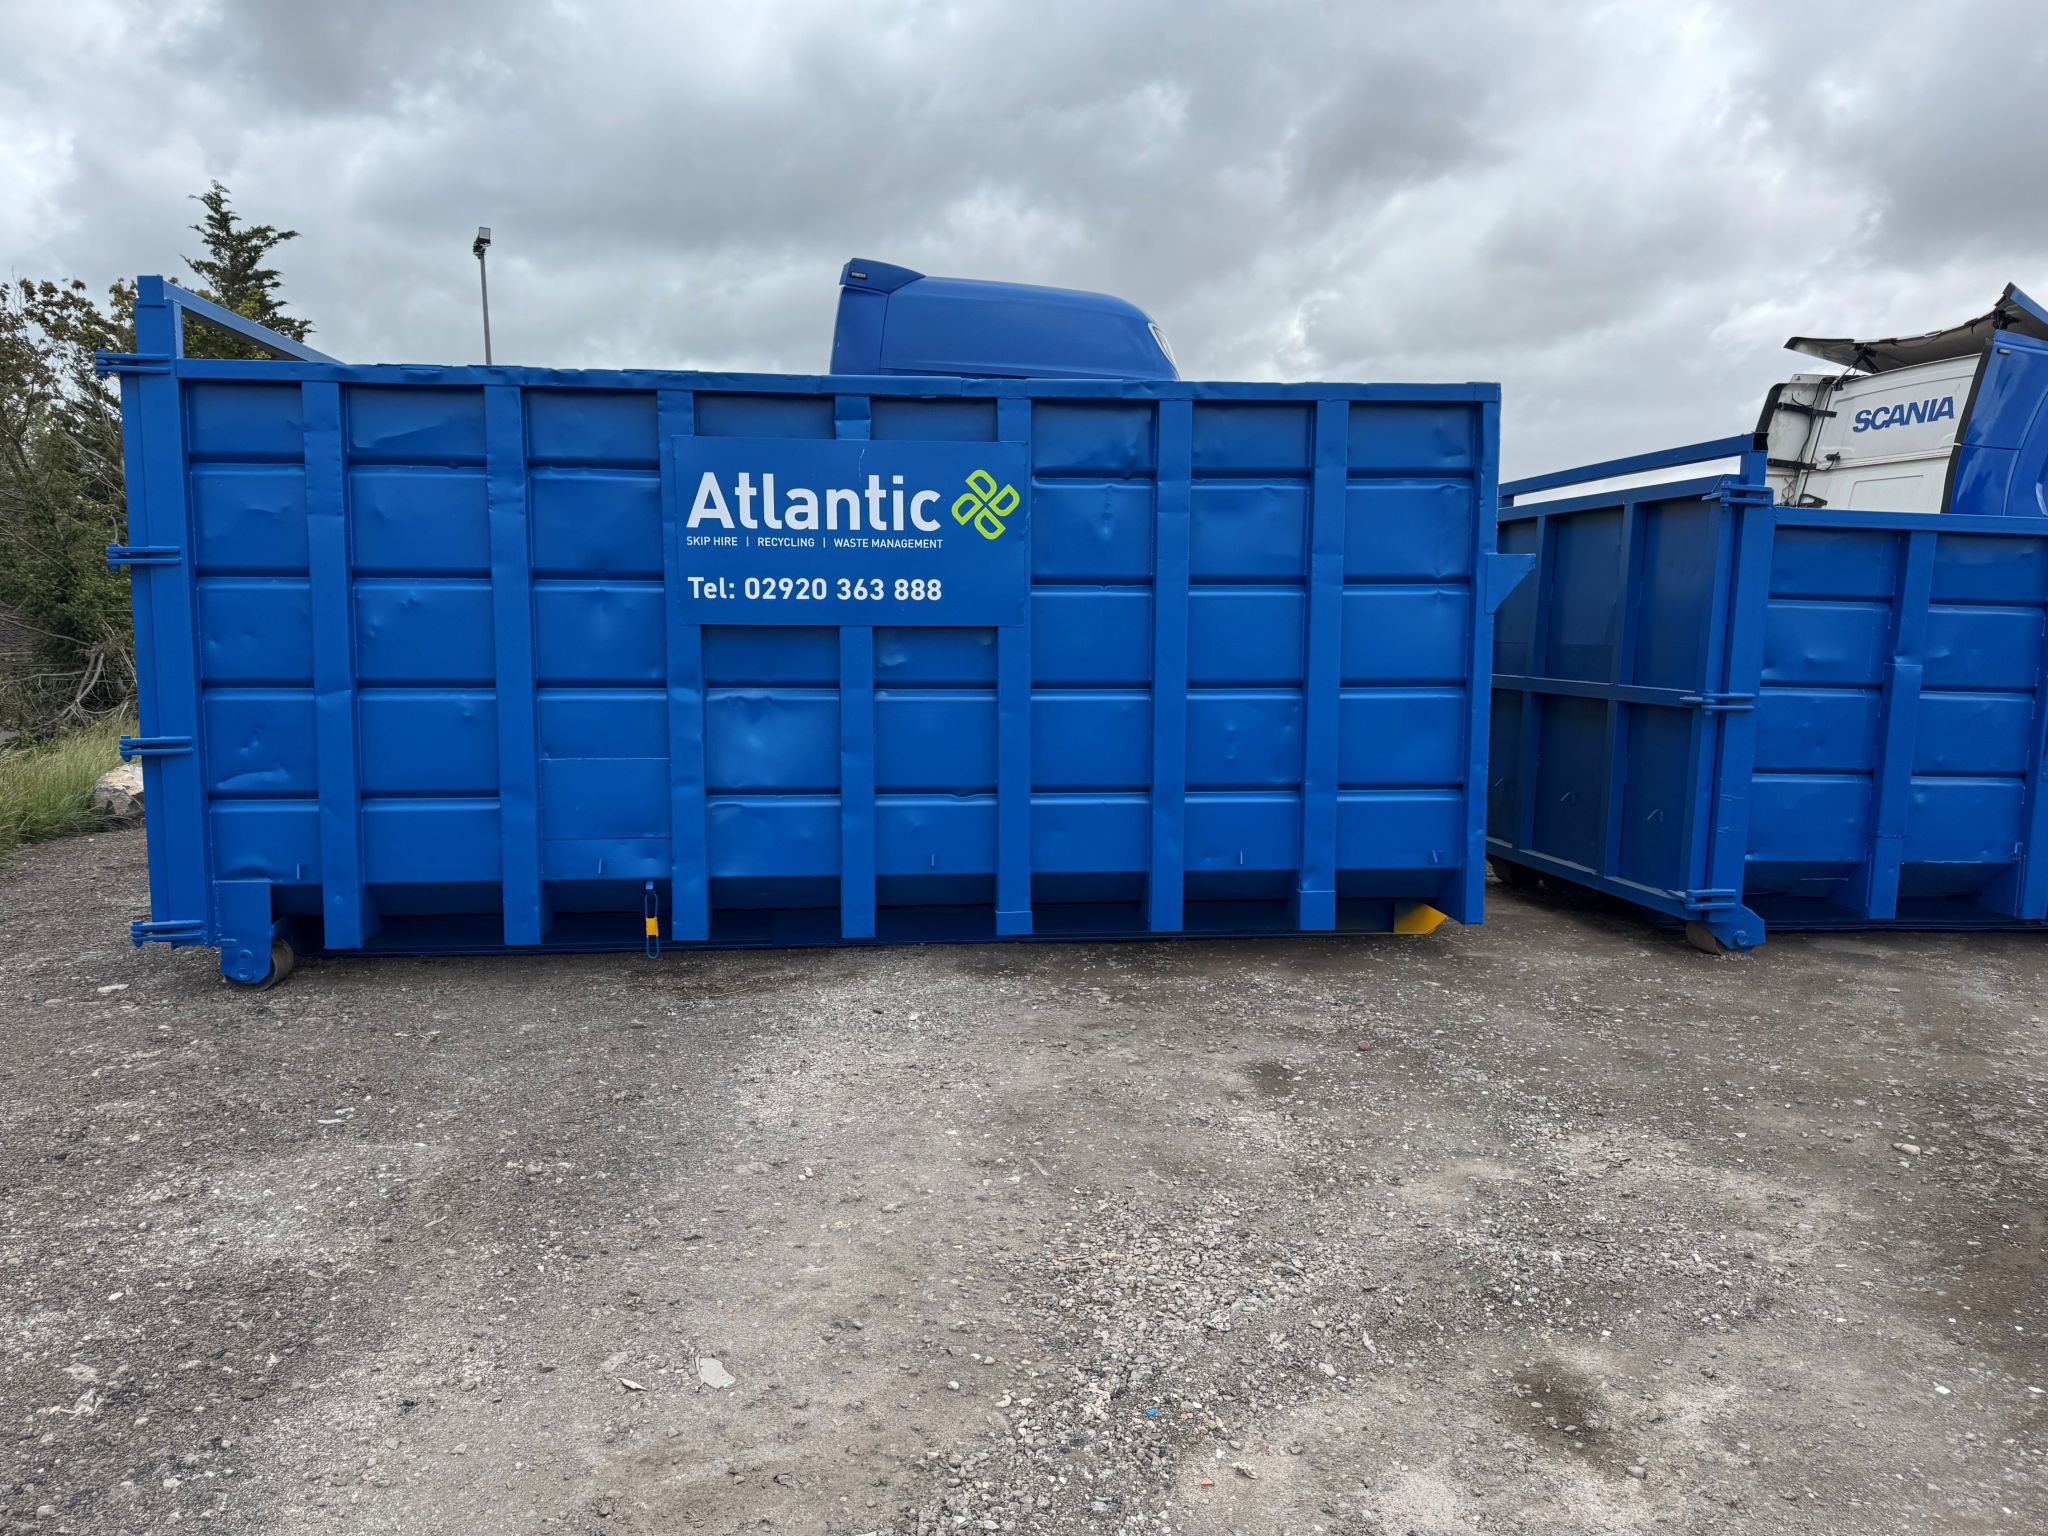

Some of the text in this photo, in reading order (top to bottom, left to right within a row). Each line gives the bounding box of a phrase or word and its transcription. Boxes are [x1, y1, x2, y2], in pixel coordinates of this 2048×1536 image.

[1852, 396, 1955, 433] SCANIA
[686, 471, 941, 532] Atlantic
[686, 536, 943, 549] SKIP HIRE RECYCLING WASTE MANAGEMENT
[687, 576, 942, 601] Tel: 02920 363 888
